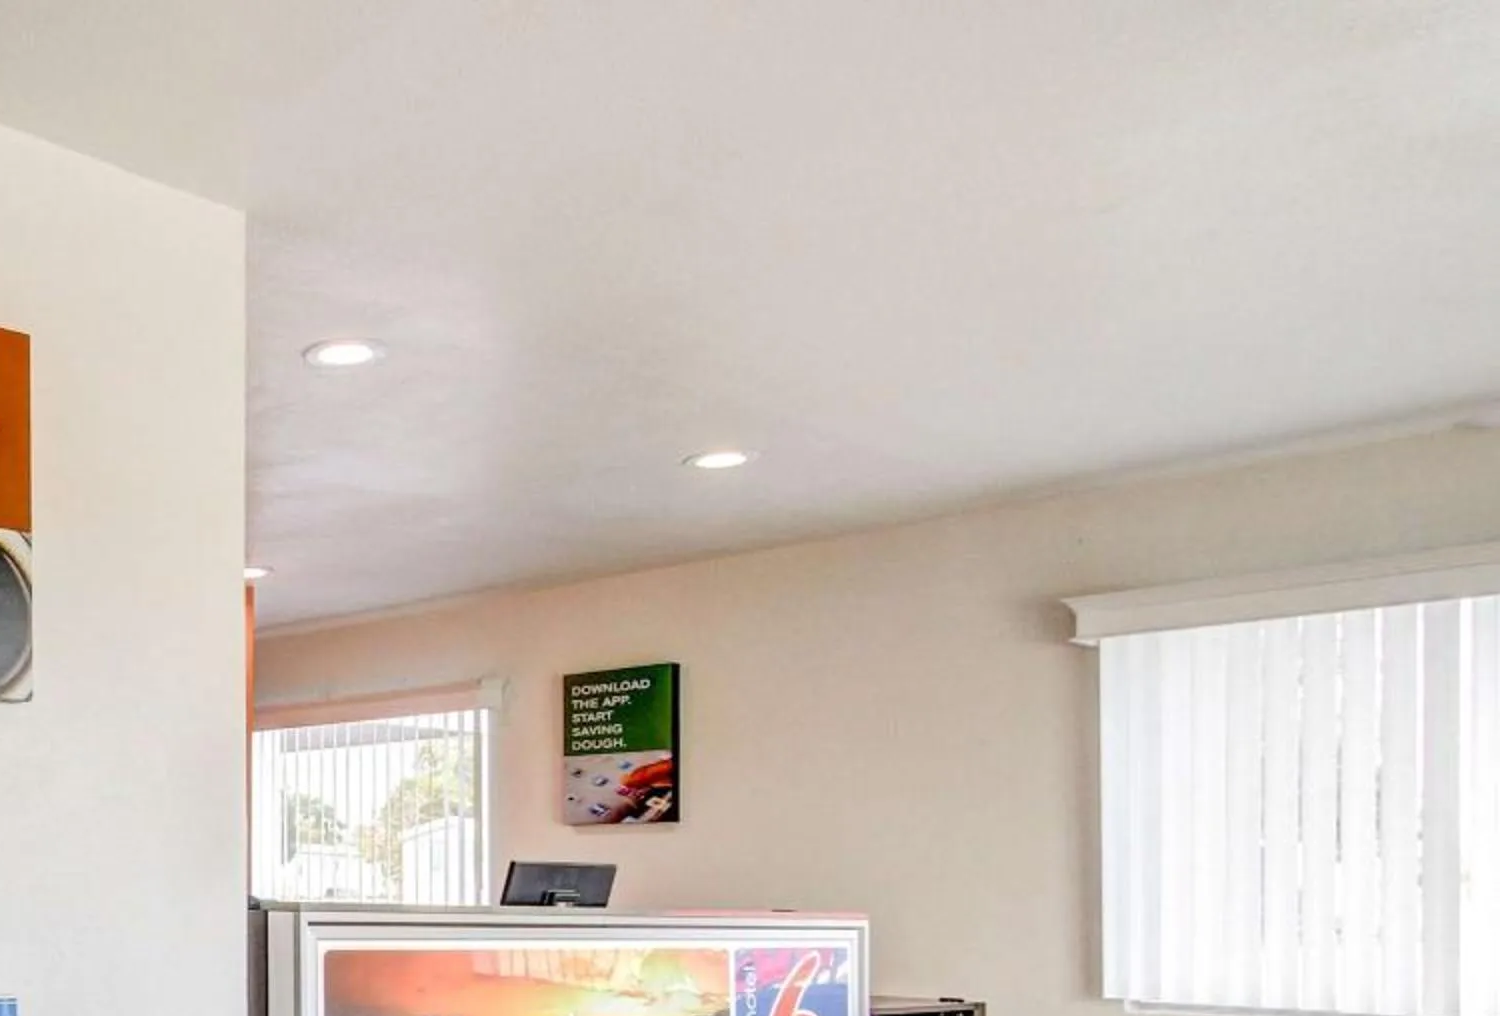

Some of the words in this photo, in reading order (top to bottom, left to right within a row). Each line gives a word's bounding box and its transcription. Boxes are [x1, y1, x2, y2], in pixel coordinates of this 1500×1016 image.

[571, 679, 651, 697] DOWNLOAD
[571, 698, 599, 711] THE
[602, 695, 632, 708] APP.
[572, 710, 614, 723] START
[571, 723, 623, 737] SAVING
[571, 738, 627, 751] DOUGH.
